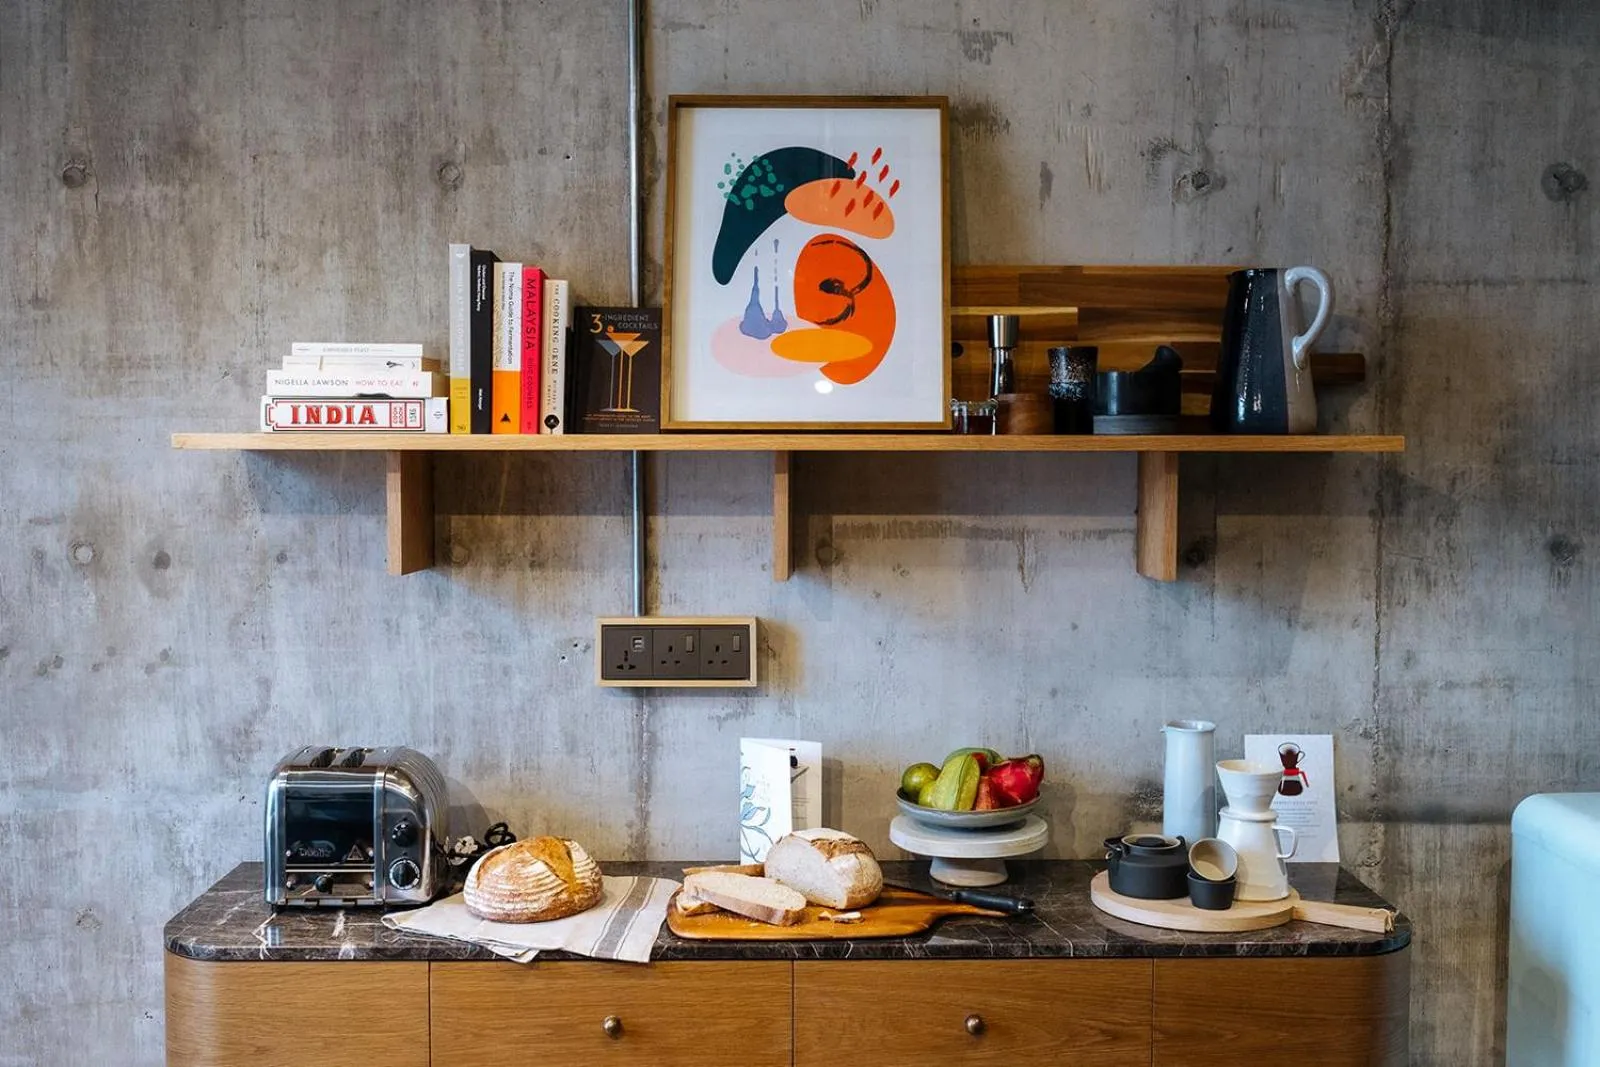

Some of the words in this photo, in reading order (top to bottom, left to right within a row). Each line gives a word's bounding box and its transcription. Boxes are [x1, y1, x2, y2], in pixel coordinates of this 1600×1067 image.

[525, 278, 537, 350] MALAYSIA
[552, 298, 560, 344] COOKING
[617, 322, 658, 330] COCKTAILS
[290, 404, 378, 425] INDIA
